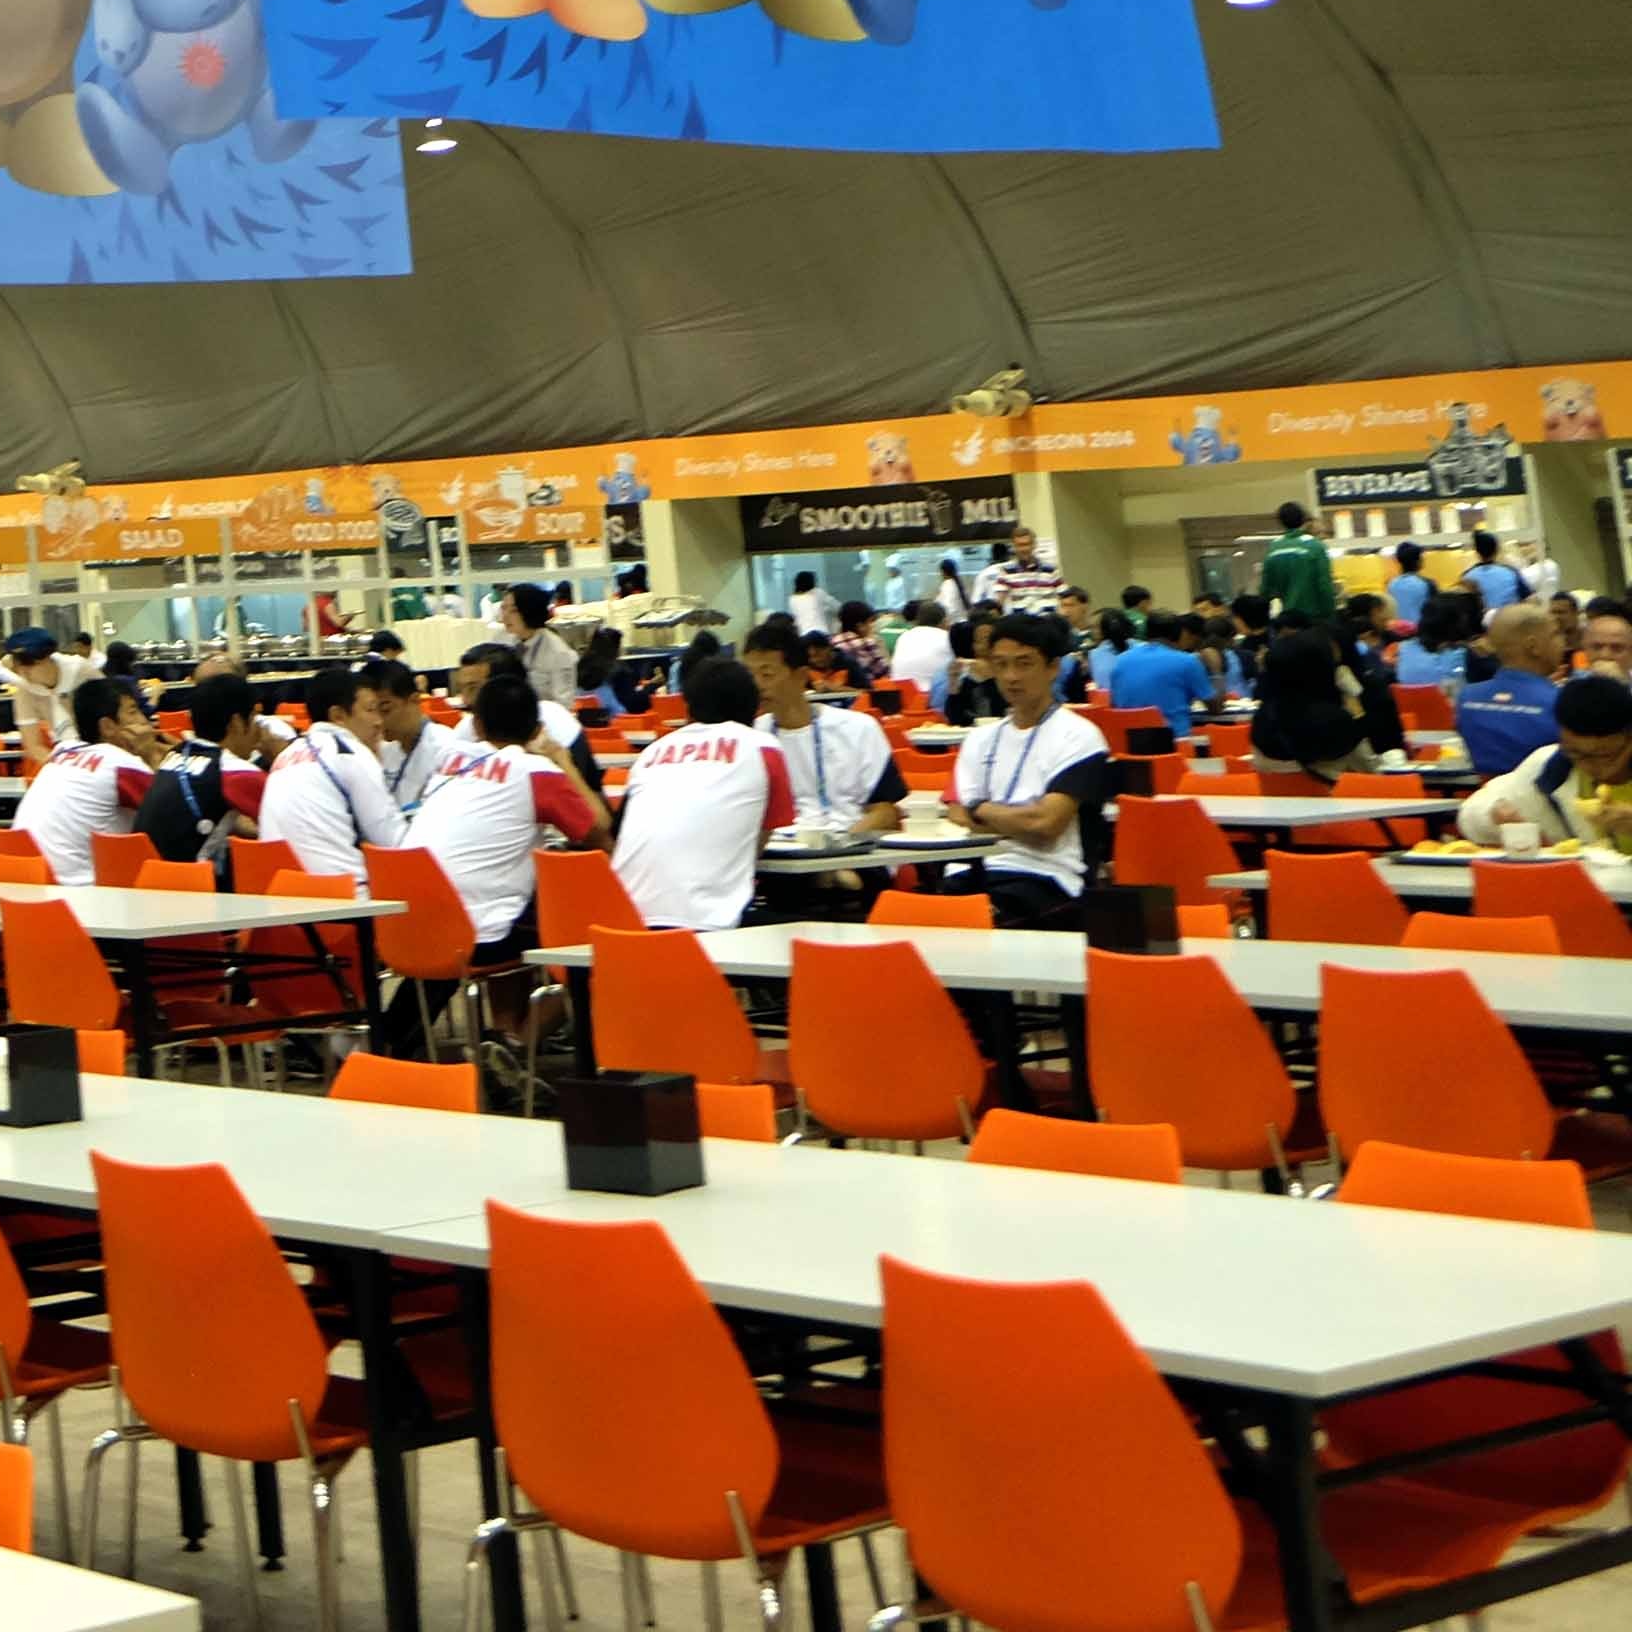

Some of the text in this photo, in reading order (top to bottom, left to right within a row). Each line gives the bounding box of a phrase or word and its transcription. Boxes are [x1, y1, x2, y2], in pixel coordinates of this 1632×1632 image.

[1322, 470, 1432, 496] BEVERAGE
[798, 496, 1018, 534] SMOOTHIE MIL
[119, 529, 184, 551] SALAD
[645, 737, 735, 768] JAPAN
